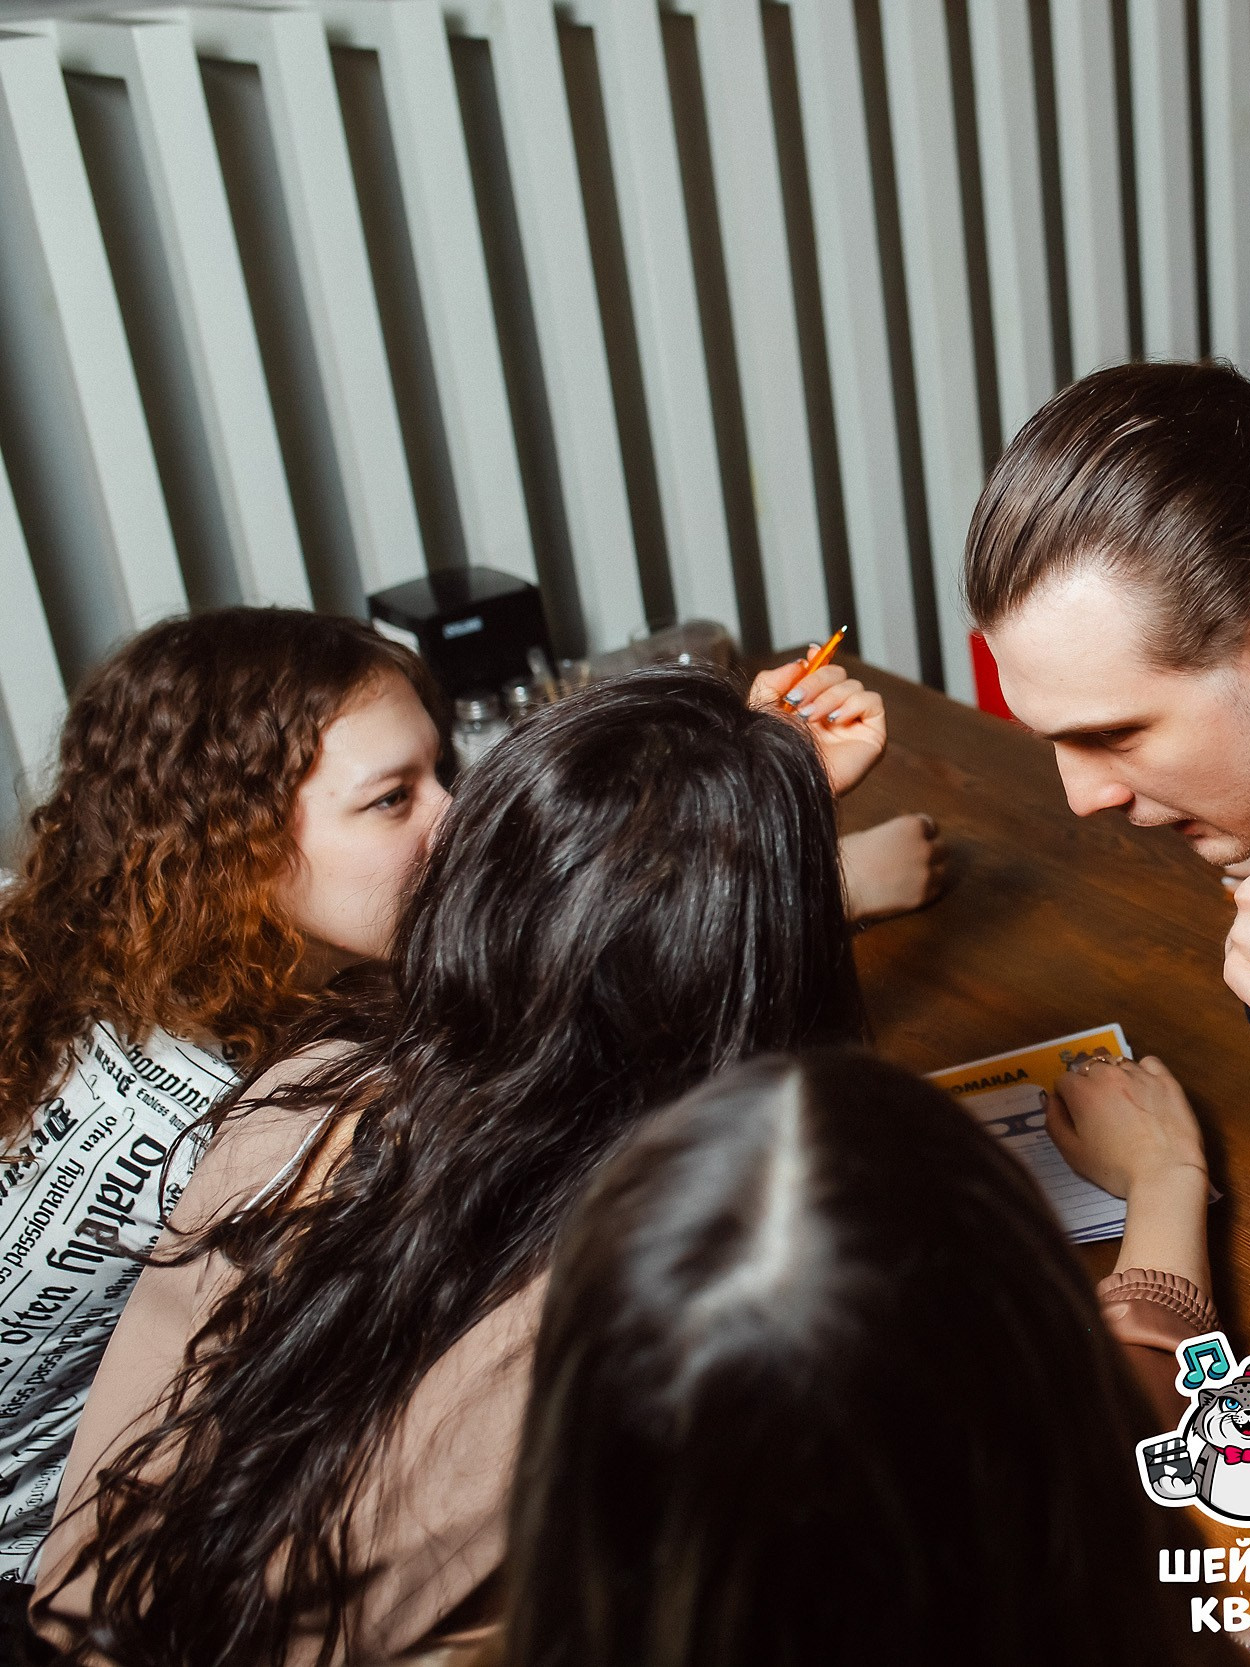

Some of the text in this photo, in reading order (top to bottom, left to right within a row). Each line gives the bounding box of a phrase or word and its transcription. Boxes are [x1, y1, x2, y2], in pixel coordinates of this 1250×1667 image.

[949, 1068, 1028, 1095] ОМАНДА
[79, 1115, 117, 1152] often
[3, 1158, 85, 1269] passionately
